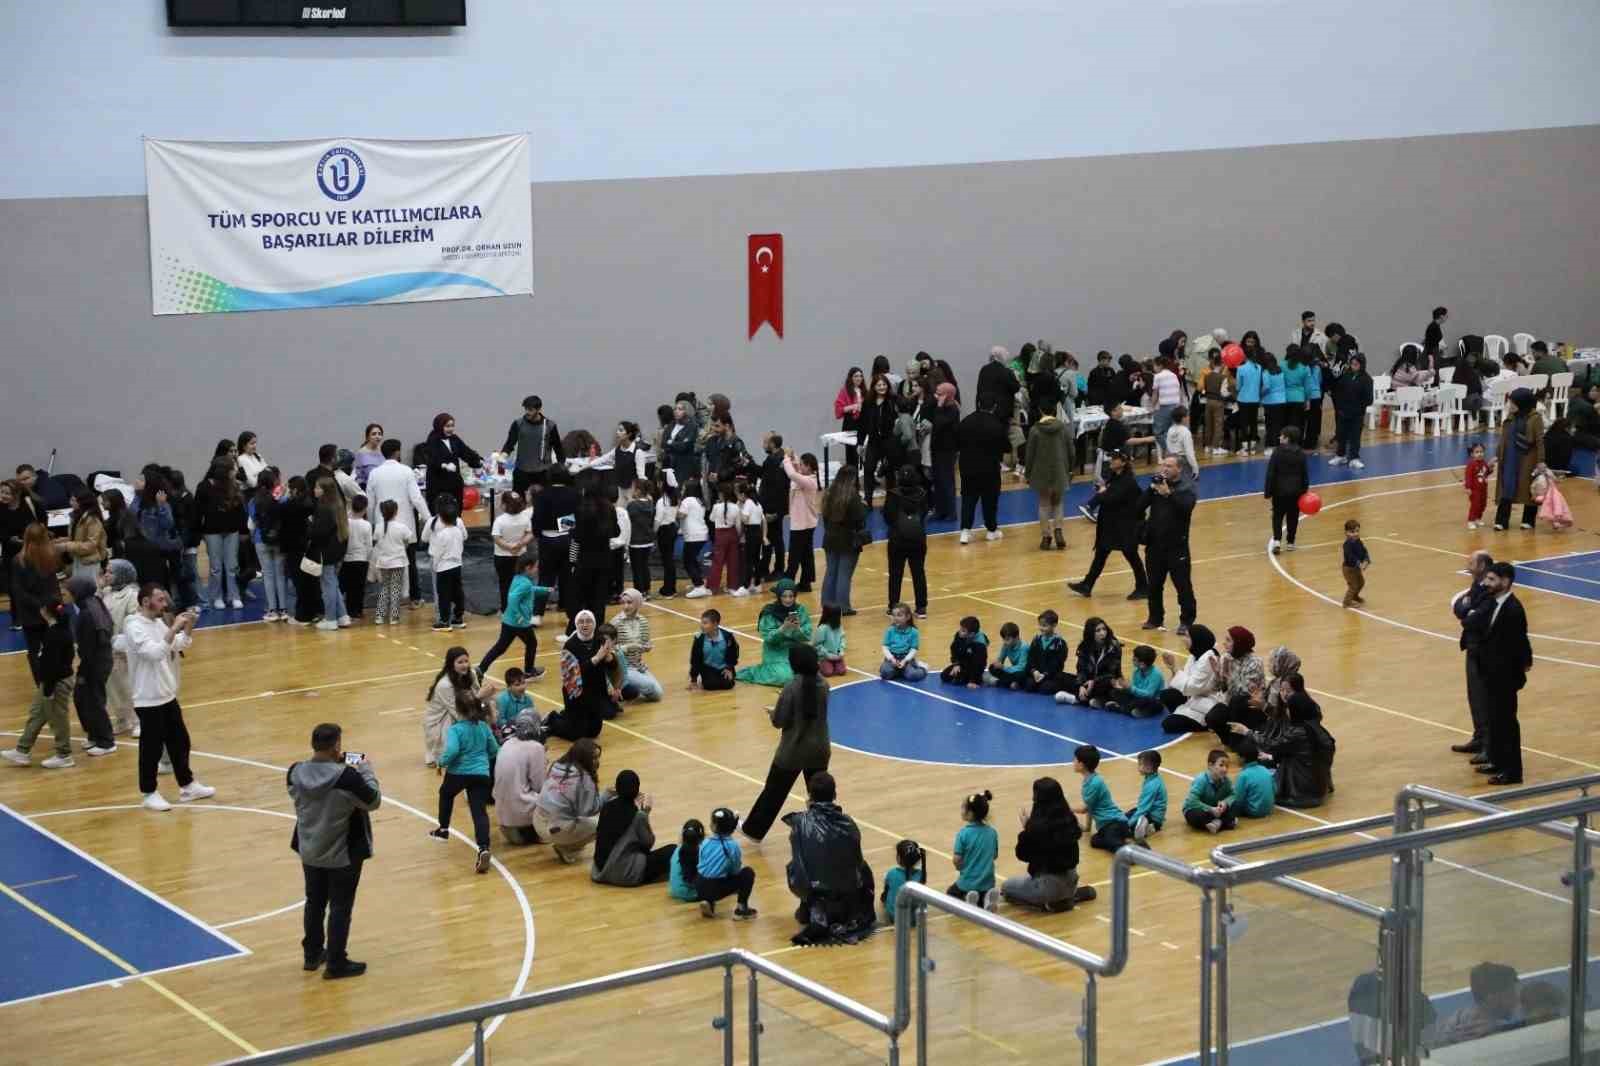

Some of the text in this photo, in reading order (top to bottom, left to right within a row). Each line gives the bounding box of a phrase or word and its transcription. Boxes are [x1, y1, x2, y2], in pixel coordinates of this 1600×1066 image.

[207, 205, 482, 229] TÜM SPORCU VE KATILIMCILARA
[262, 225, 434, 252] BAŞARILAR DİLERİM
[475, 243, 501, 251] ORHAN
